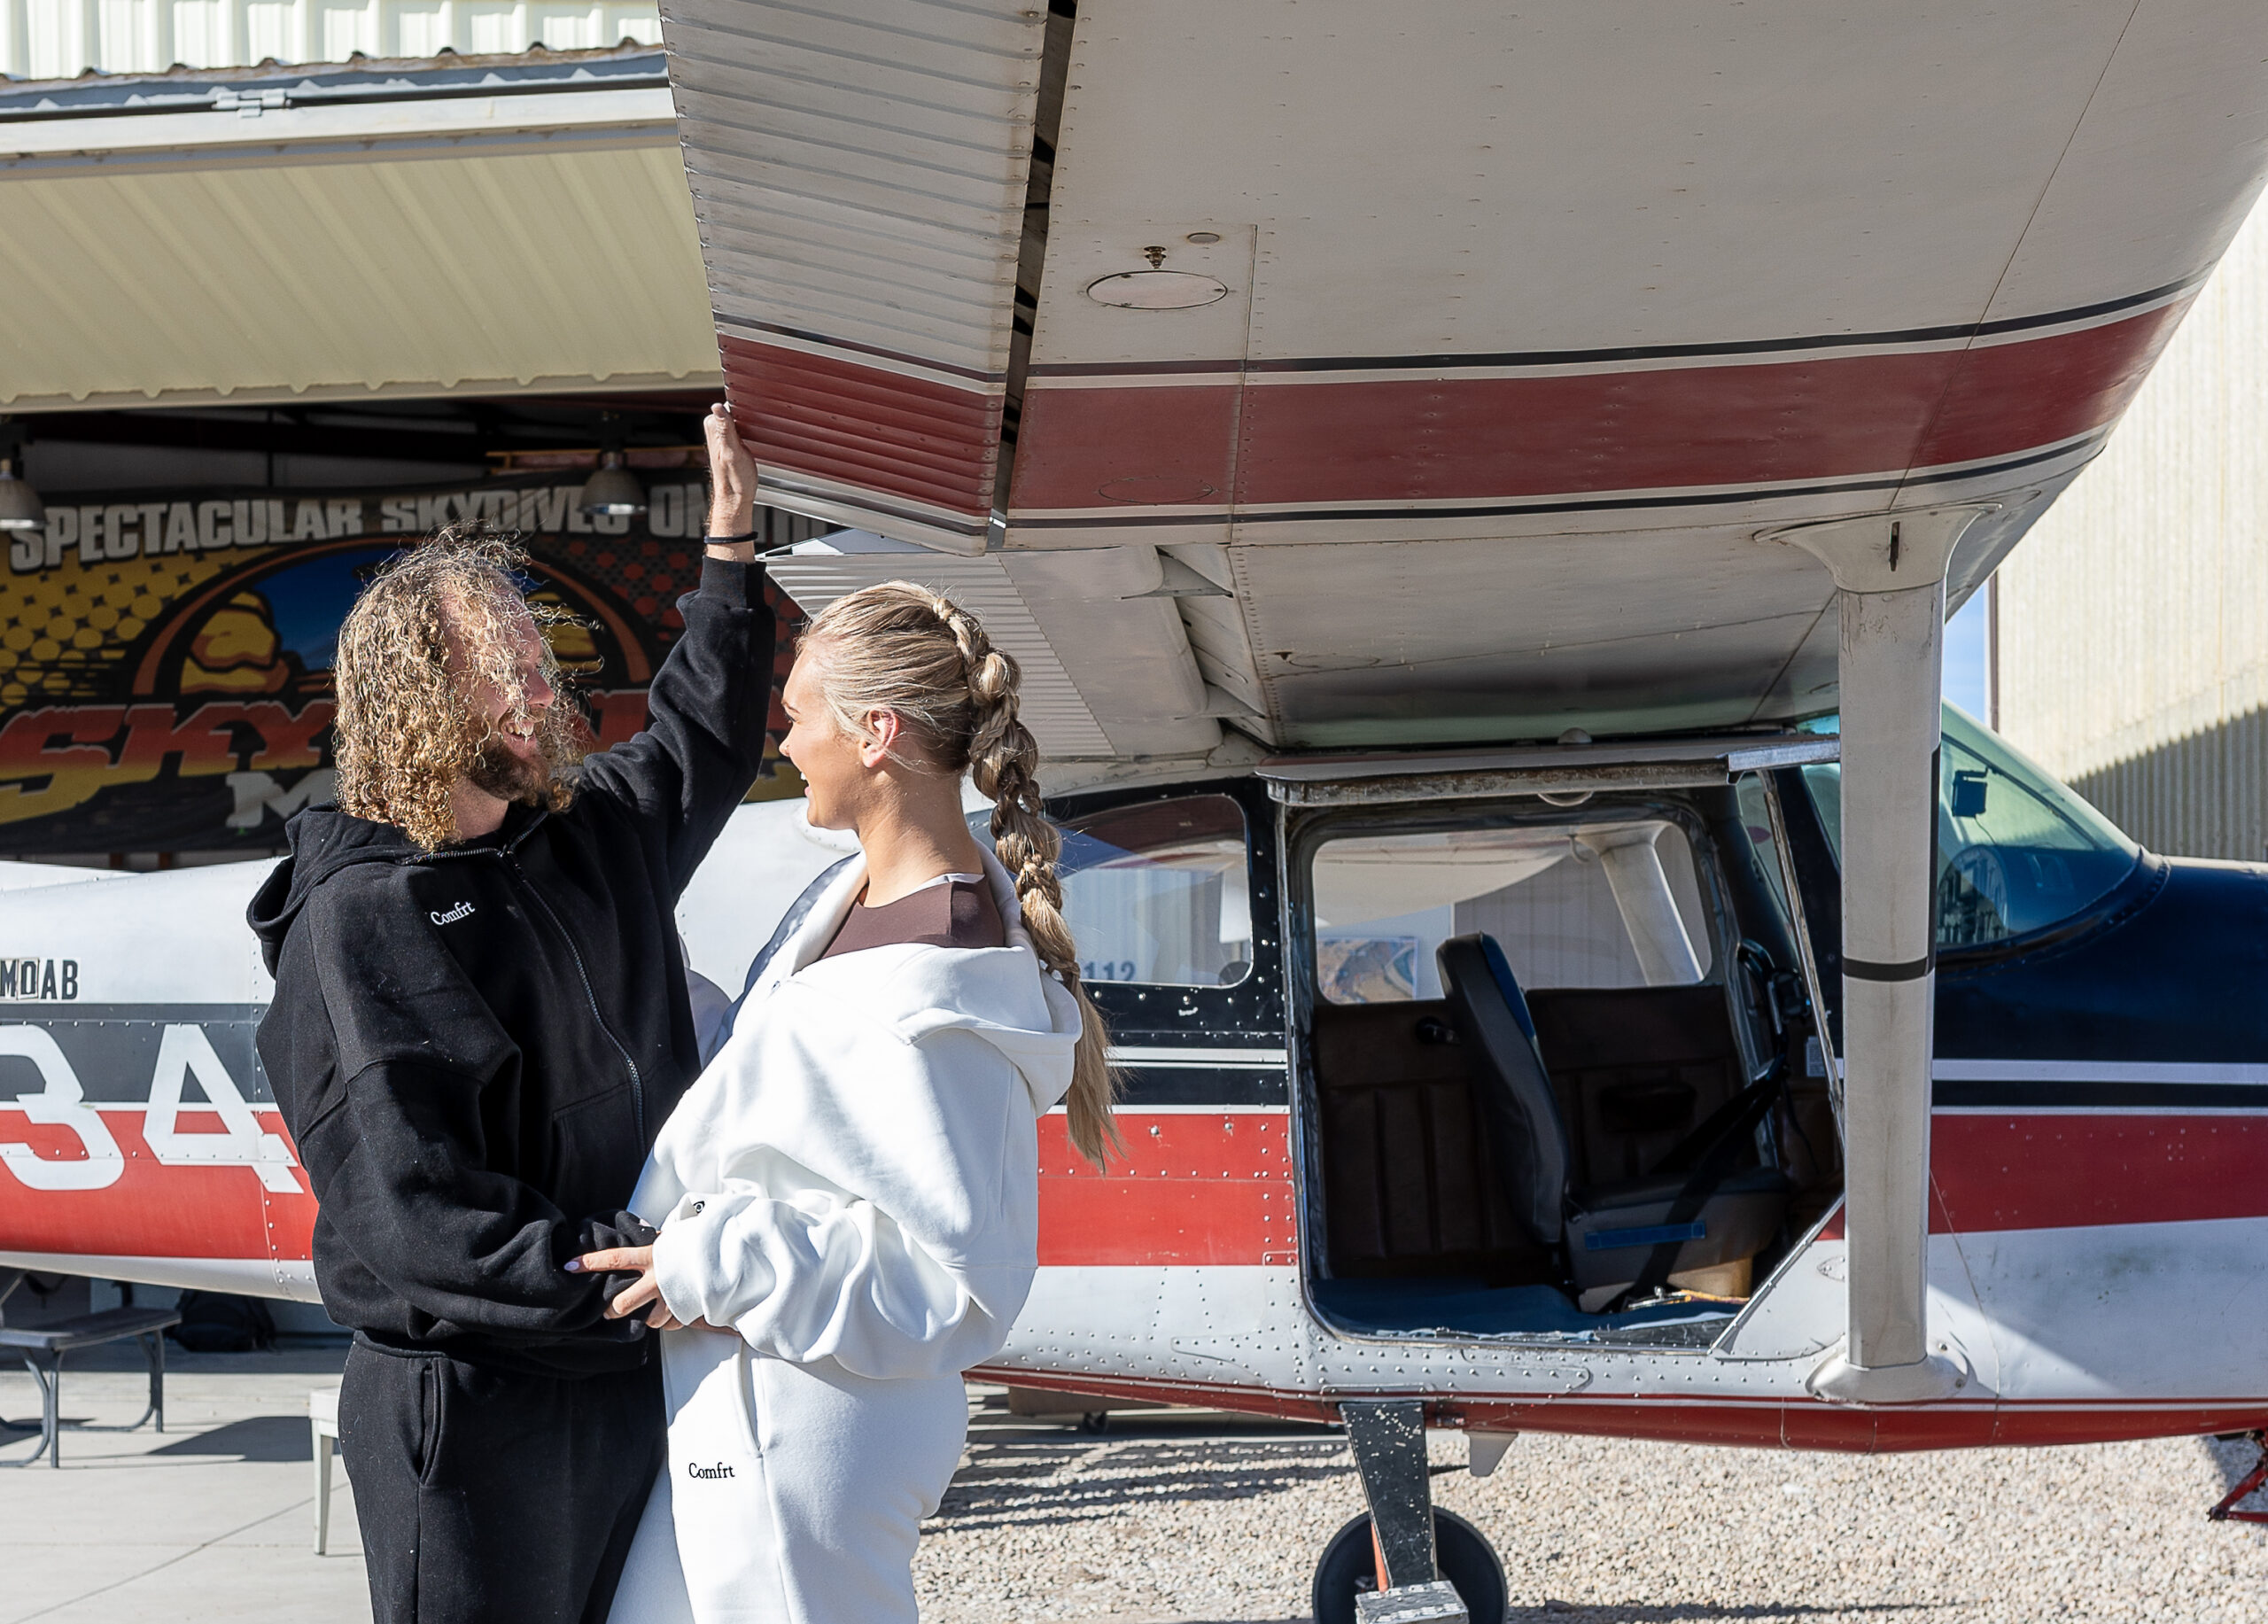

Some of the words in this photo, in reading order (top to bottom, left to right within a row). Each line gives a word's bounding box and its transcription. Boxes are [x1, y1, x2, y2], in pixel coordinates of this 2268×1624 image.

[11, 499, 364, 571] SPECTACULAR
[430, 901, 476, 925] Comfrt
[0, 959, 79, 1000] MOAB
[688, 1461, 736, 1480] Comfrt
